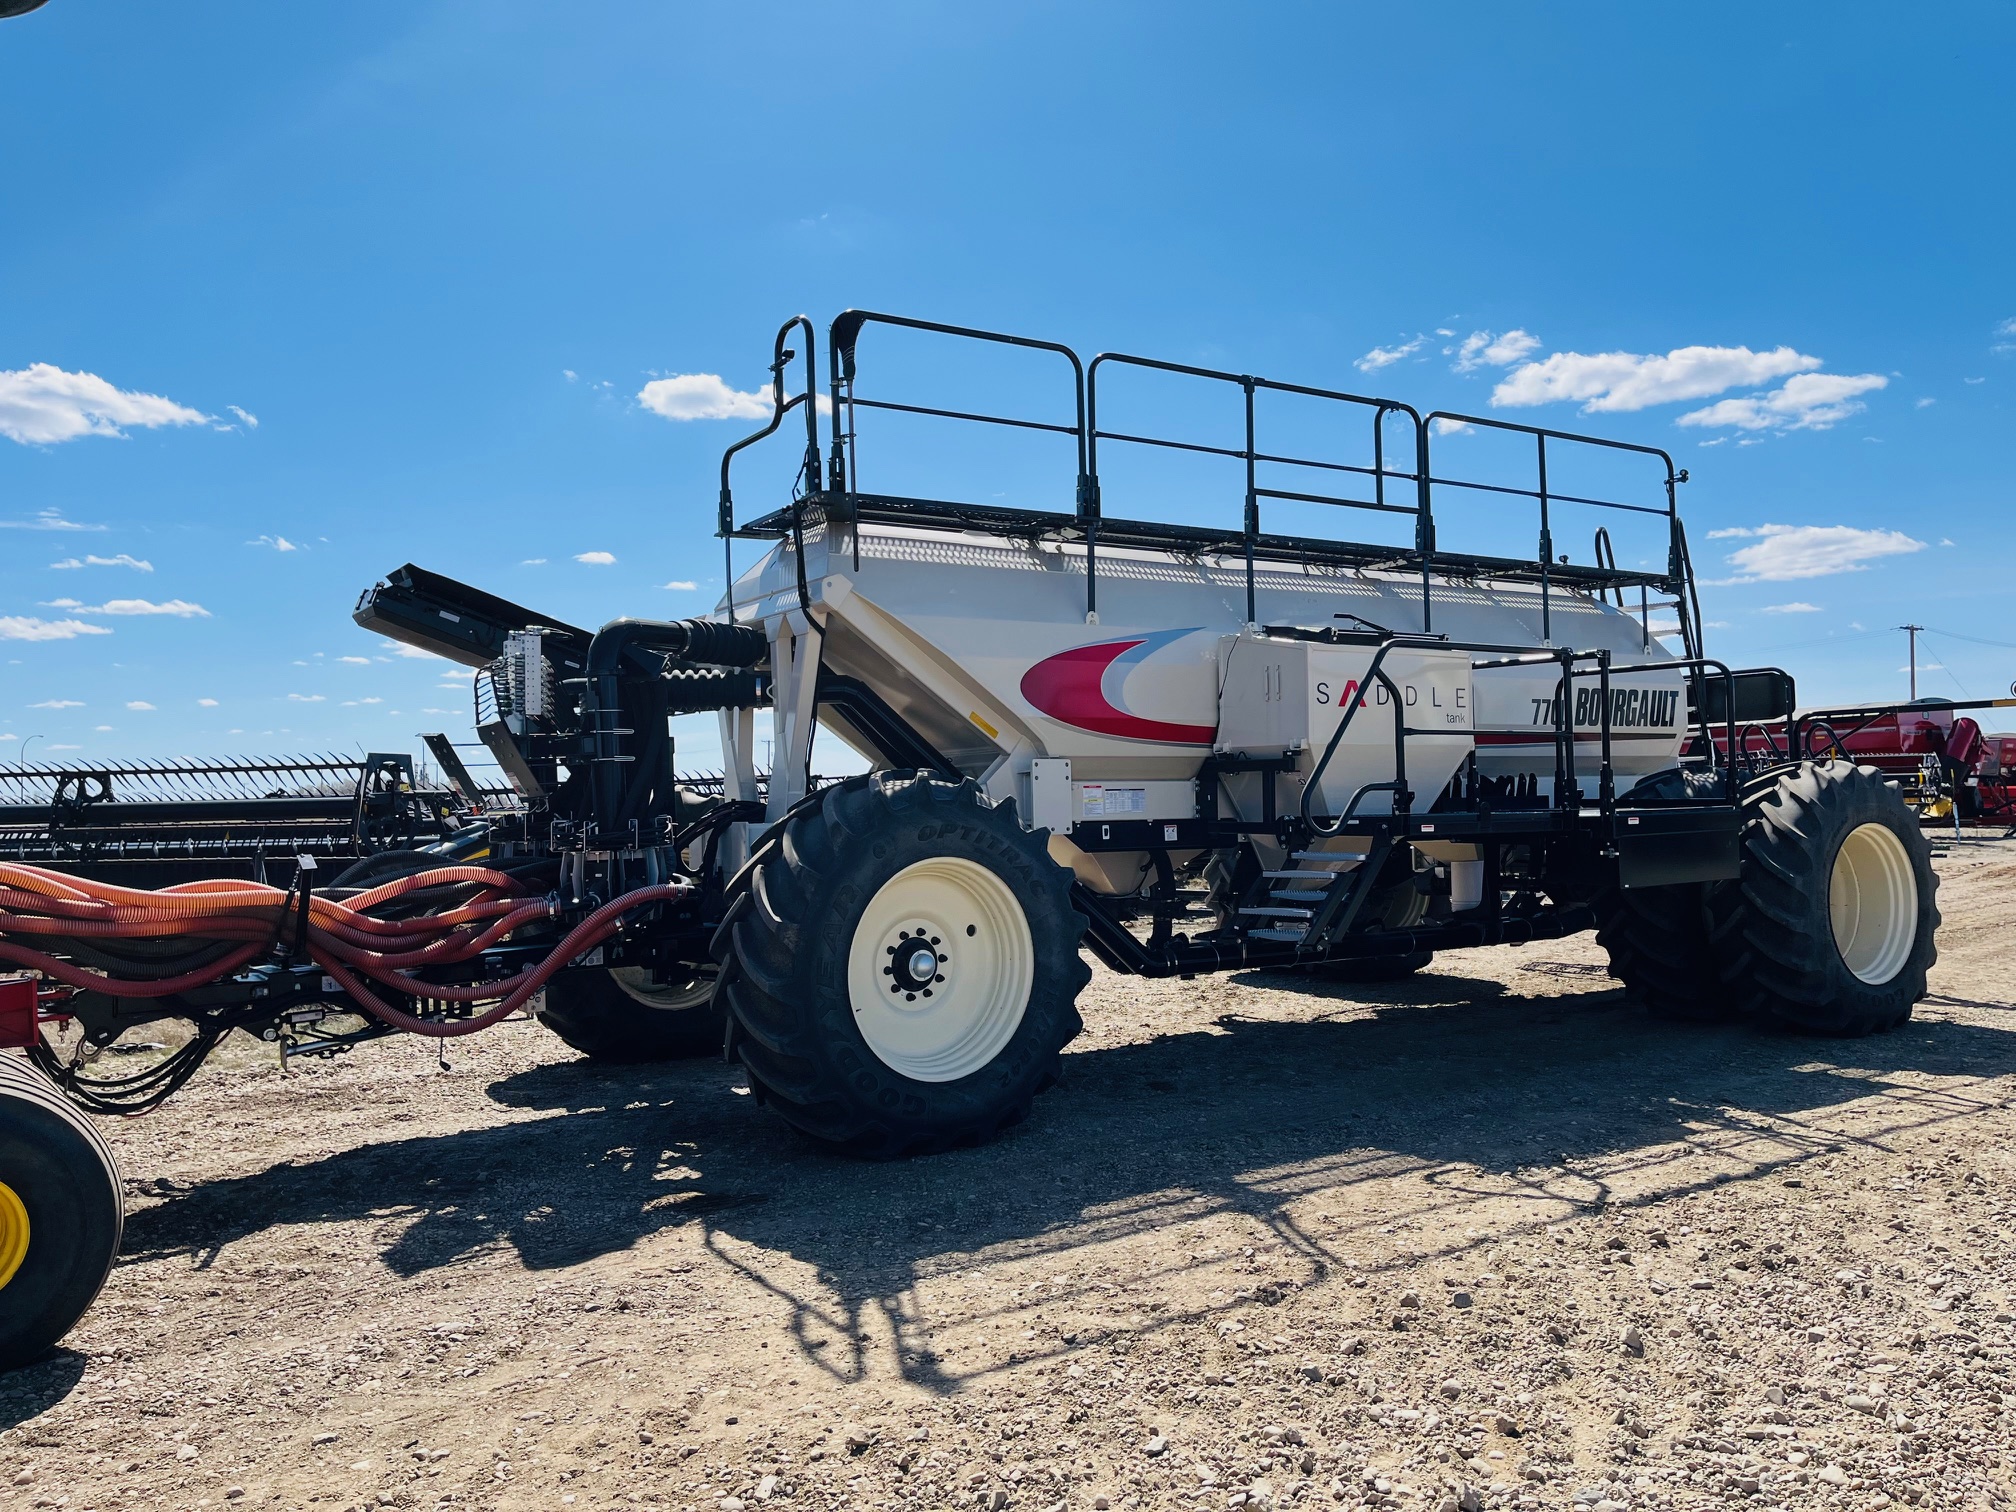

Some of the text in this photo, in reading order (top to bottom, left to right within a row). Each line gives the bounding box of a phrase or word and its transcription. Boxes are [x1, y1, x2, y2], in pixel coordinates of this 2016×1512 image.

[1316, 680, 1466, 708] SADDLE
[1446, 713, 1466, 724] tank
[917, 823, 1047, 898] OPTITRAC
[816, 883, 927, 1117] GOODYEAR
